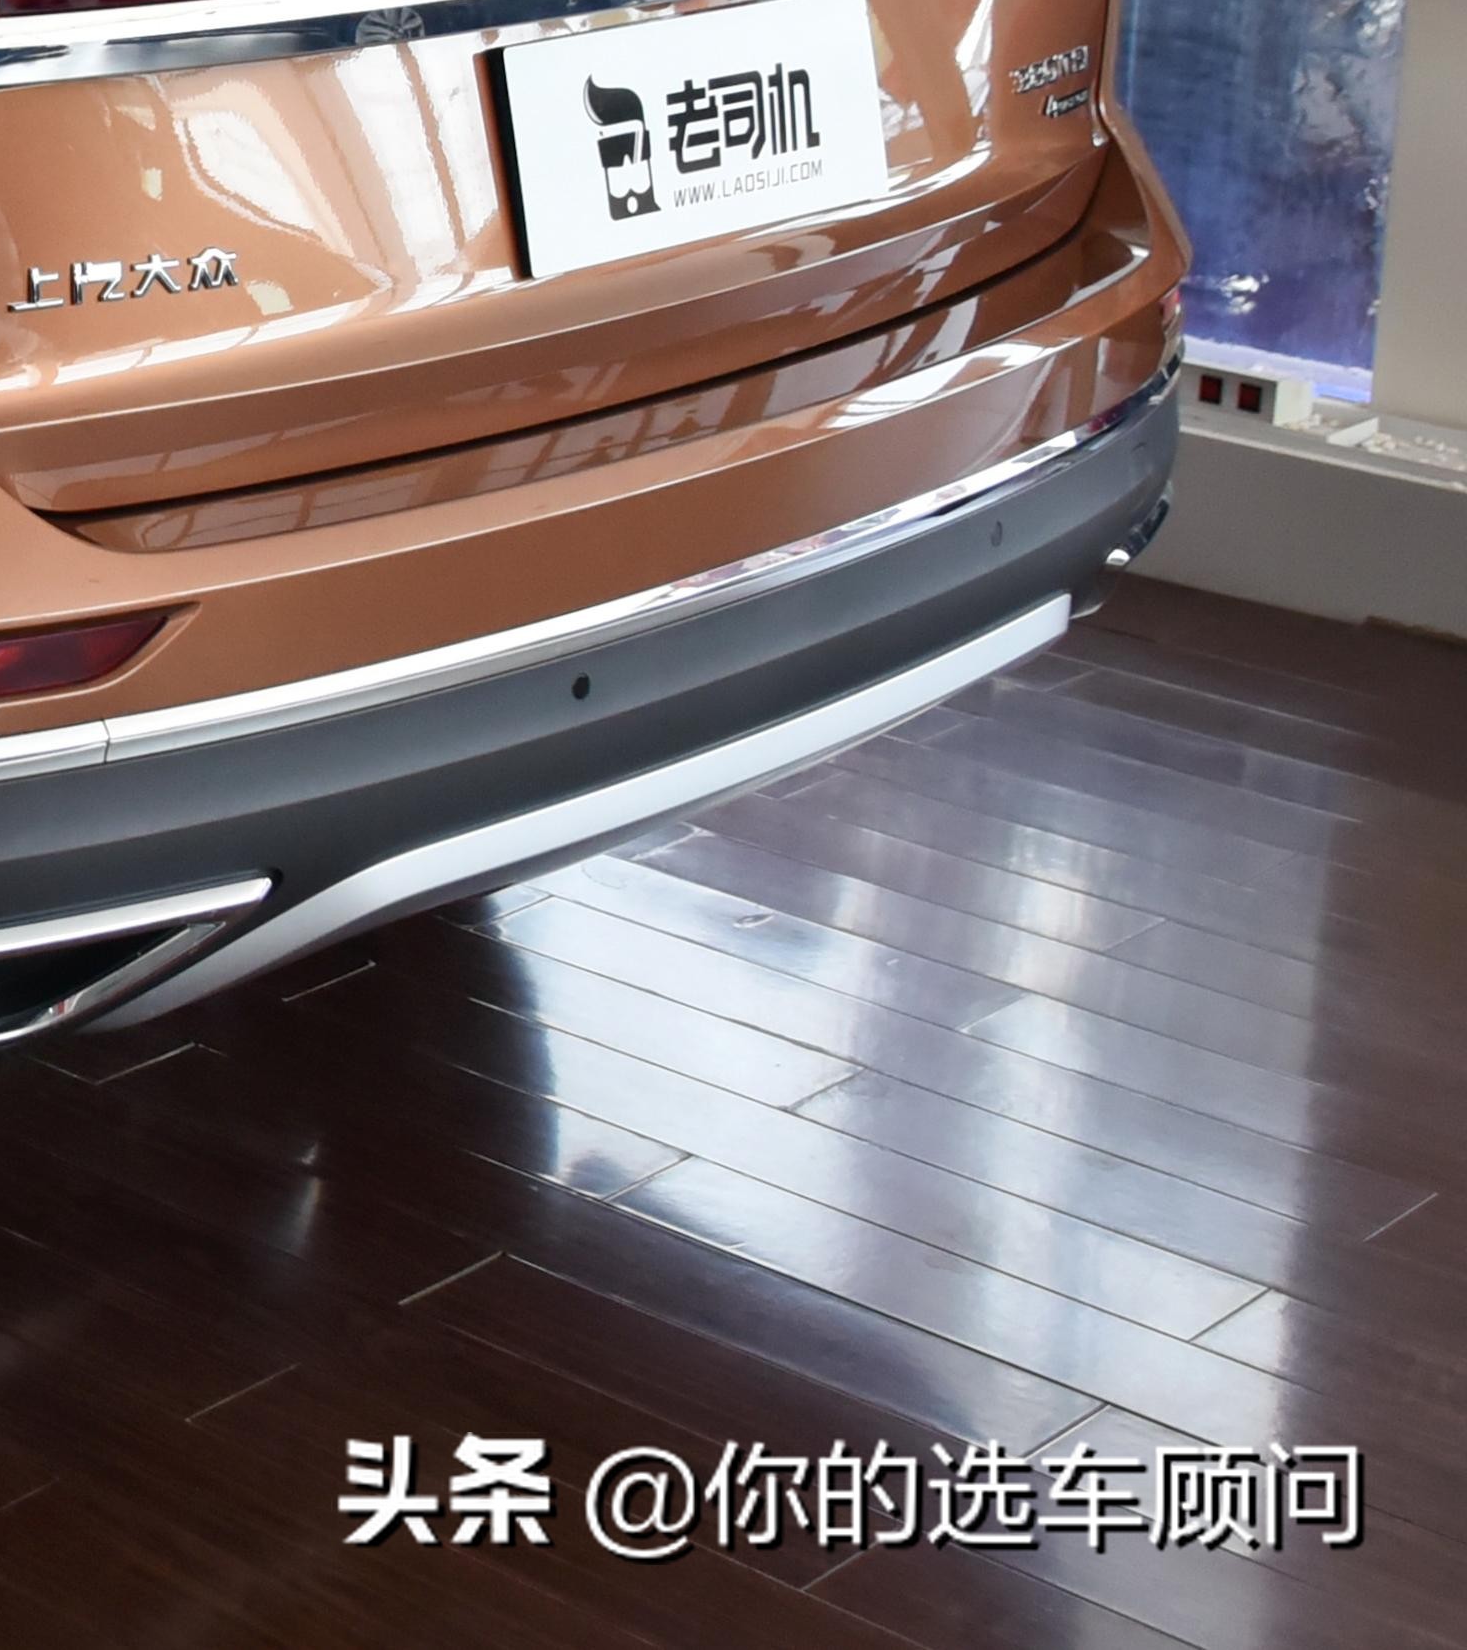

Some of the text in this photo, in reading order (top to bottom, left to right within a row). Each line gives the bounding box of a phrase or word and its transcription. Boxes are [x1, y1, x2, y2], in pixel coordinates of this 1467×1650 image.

[666, 63, 820, 175] 老司机
[673, 160, 823, 208] WWW.LAOSIJI.COM
[7, 247, 239, 312] 上汽大众
